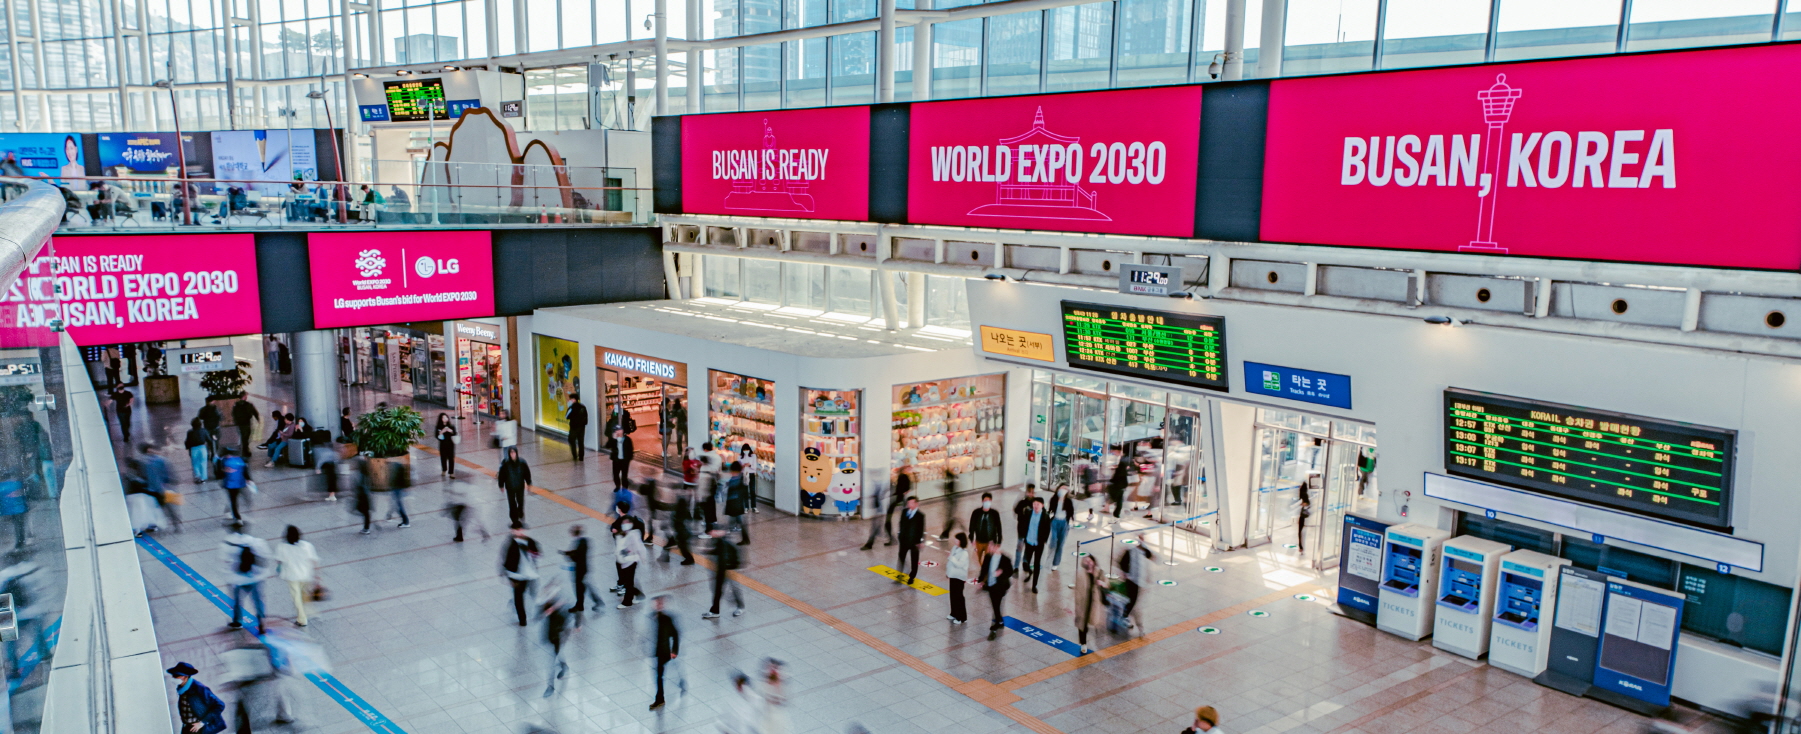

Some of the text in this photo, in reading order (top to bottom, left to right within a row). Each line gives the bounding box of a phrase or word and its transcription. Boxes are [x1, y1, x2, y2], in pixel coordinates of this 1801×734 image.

[712, 149, 828, 180] BUSAN IS READY
[932, 141, 1166, 184] WORLD EXPO 2030
[1341, 129, 1676, 197] BUSAN, KOREA
[83, 254, 98, 272] IS
[100, 254, 143, 271] READY
[438, 258, 460, 274] LG
[58, 274, 118, 301] ORLD
[123, 272, 180, 298] EXPO
[183, 270, 238, 294] 2030
[334, 291, 477, 310] LG supports Busan's bid for World EXPO 2030
[128, 297, 198, 322] KOREA
[456, 323, 475, 337] Weeny
[990, 332, 1014, 346] 나오는
[604, 352, 676, 379] KAKAO FRIENDS
[1292, 374, 1311, 388] 타는
[1317, 378, 1327, 391] 곳
[1455, 419, 1476, 429] 12:57
[1531, 410, 1560, 423] KORAIL
[1565, 416, 1594, 429] 승차권
[1455, 444, 1476, 454] 13:07
[1455, 456, 1476, 466] 13:17
[1719, 564, 1728, 573] 12
[1382, 602, 1415, 617] TICKETS
[1439, 617, 1474, 634] TICKETS
[1496, 636, 1533, 653] TICKETS
